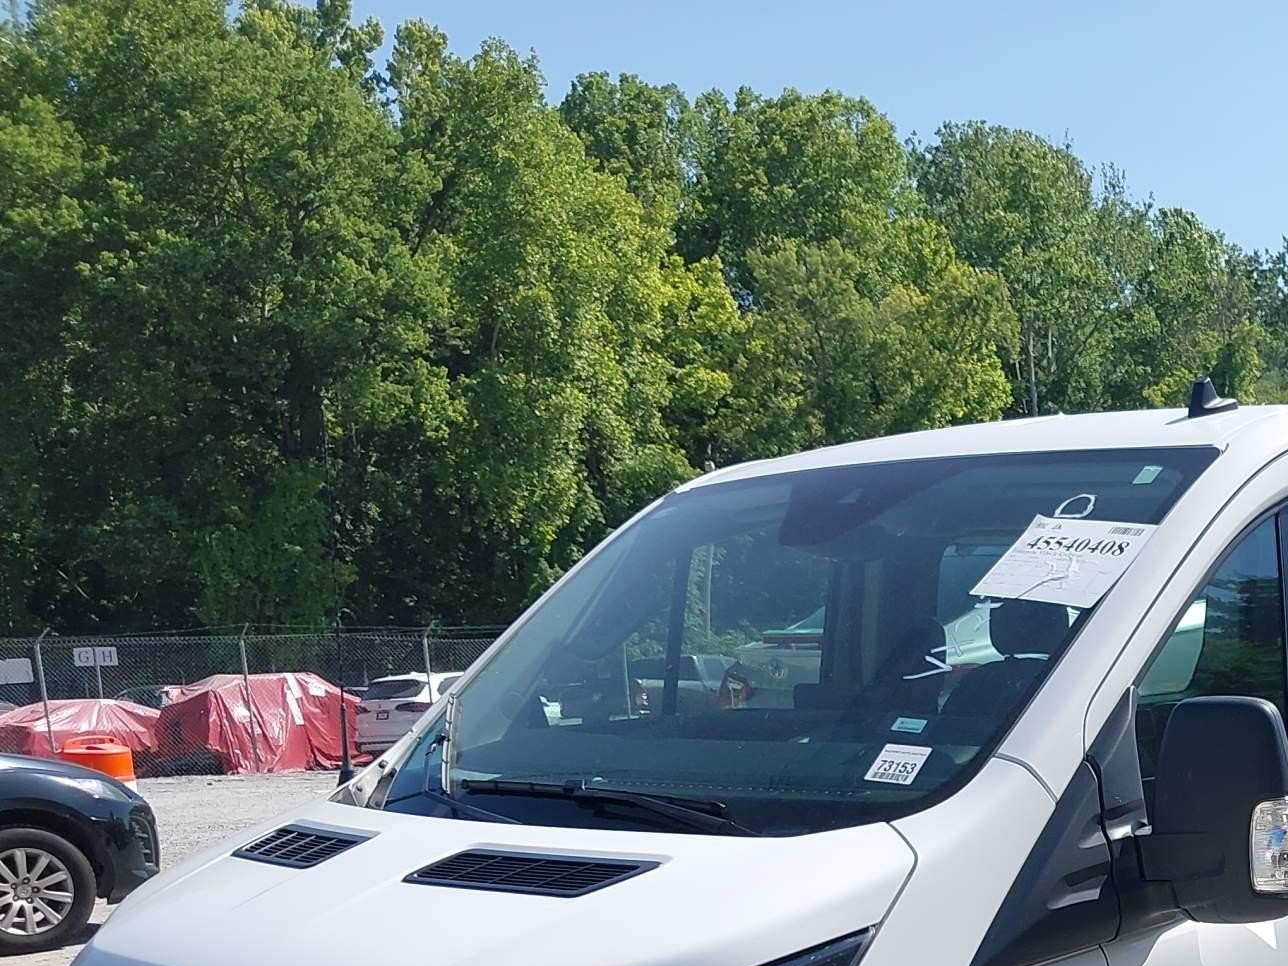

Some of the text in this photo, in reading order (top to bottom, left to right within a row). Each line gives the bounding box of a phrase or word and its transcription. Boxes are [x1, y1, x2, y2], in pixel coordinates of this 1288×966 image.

[1027, 536, 1130, 557] 45540408
[78, 650, 113, 664] G H
[876, 759, 917, 775] 73153
